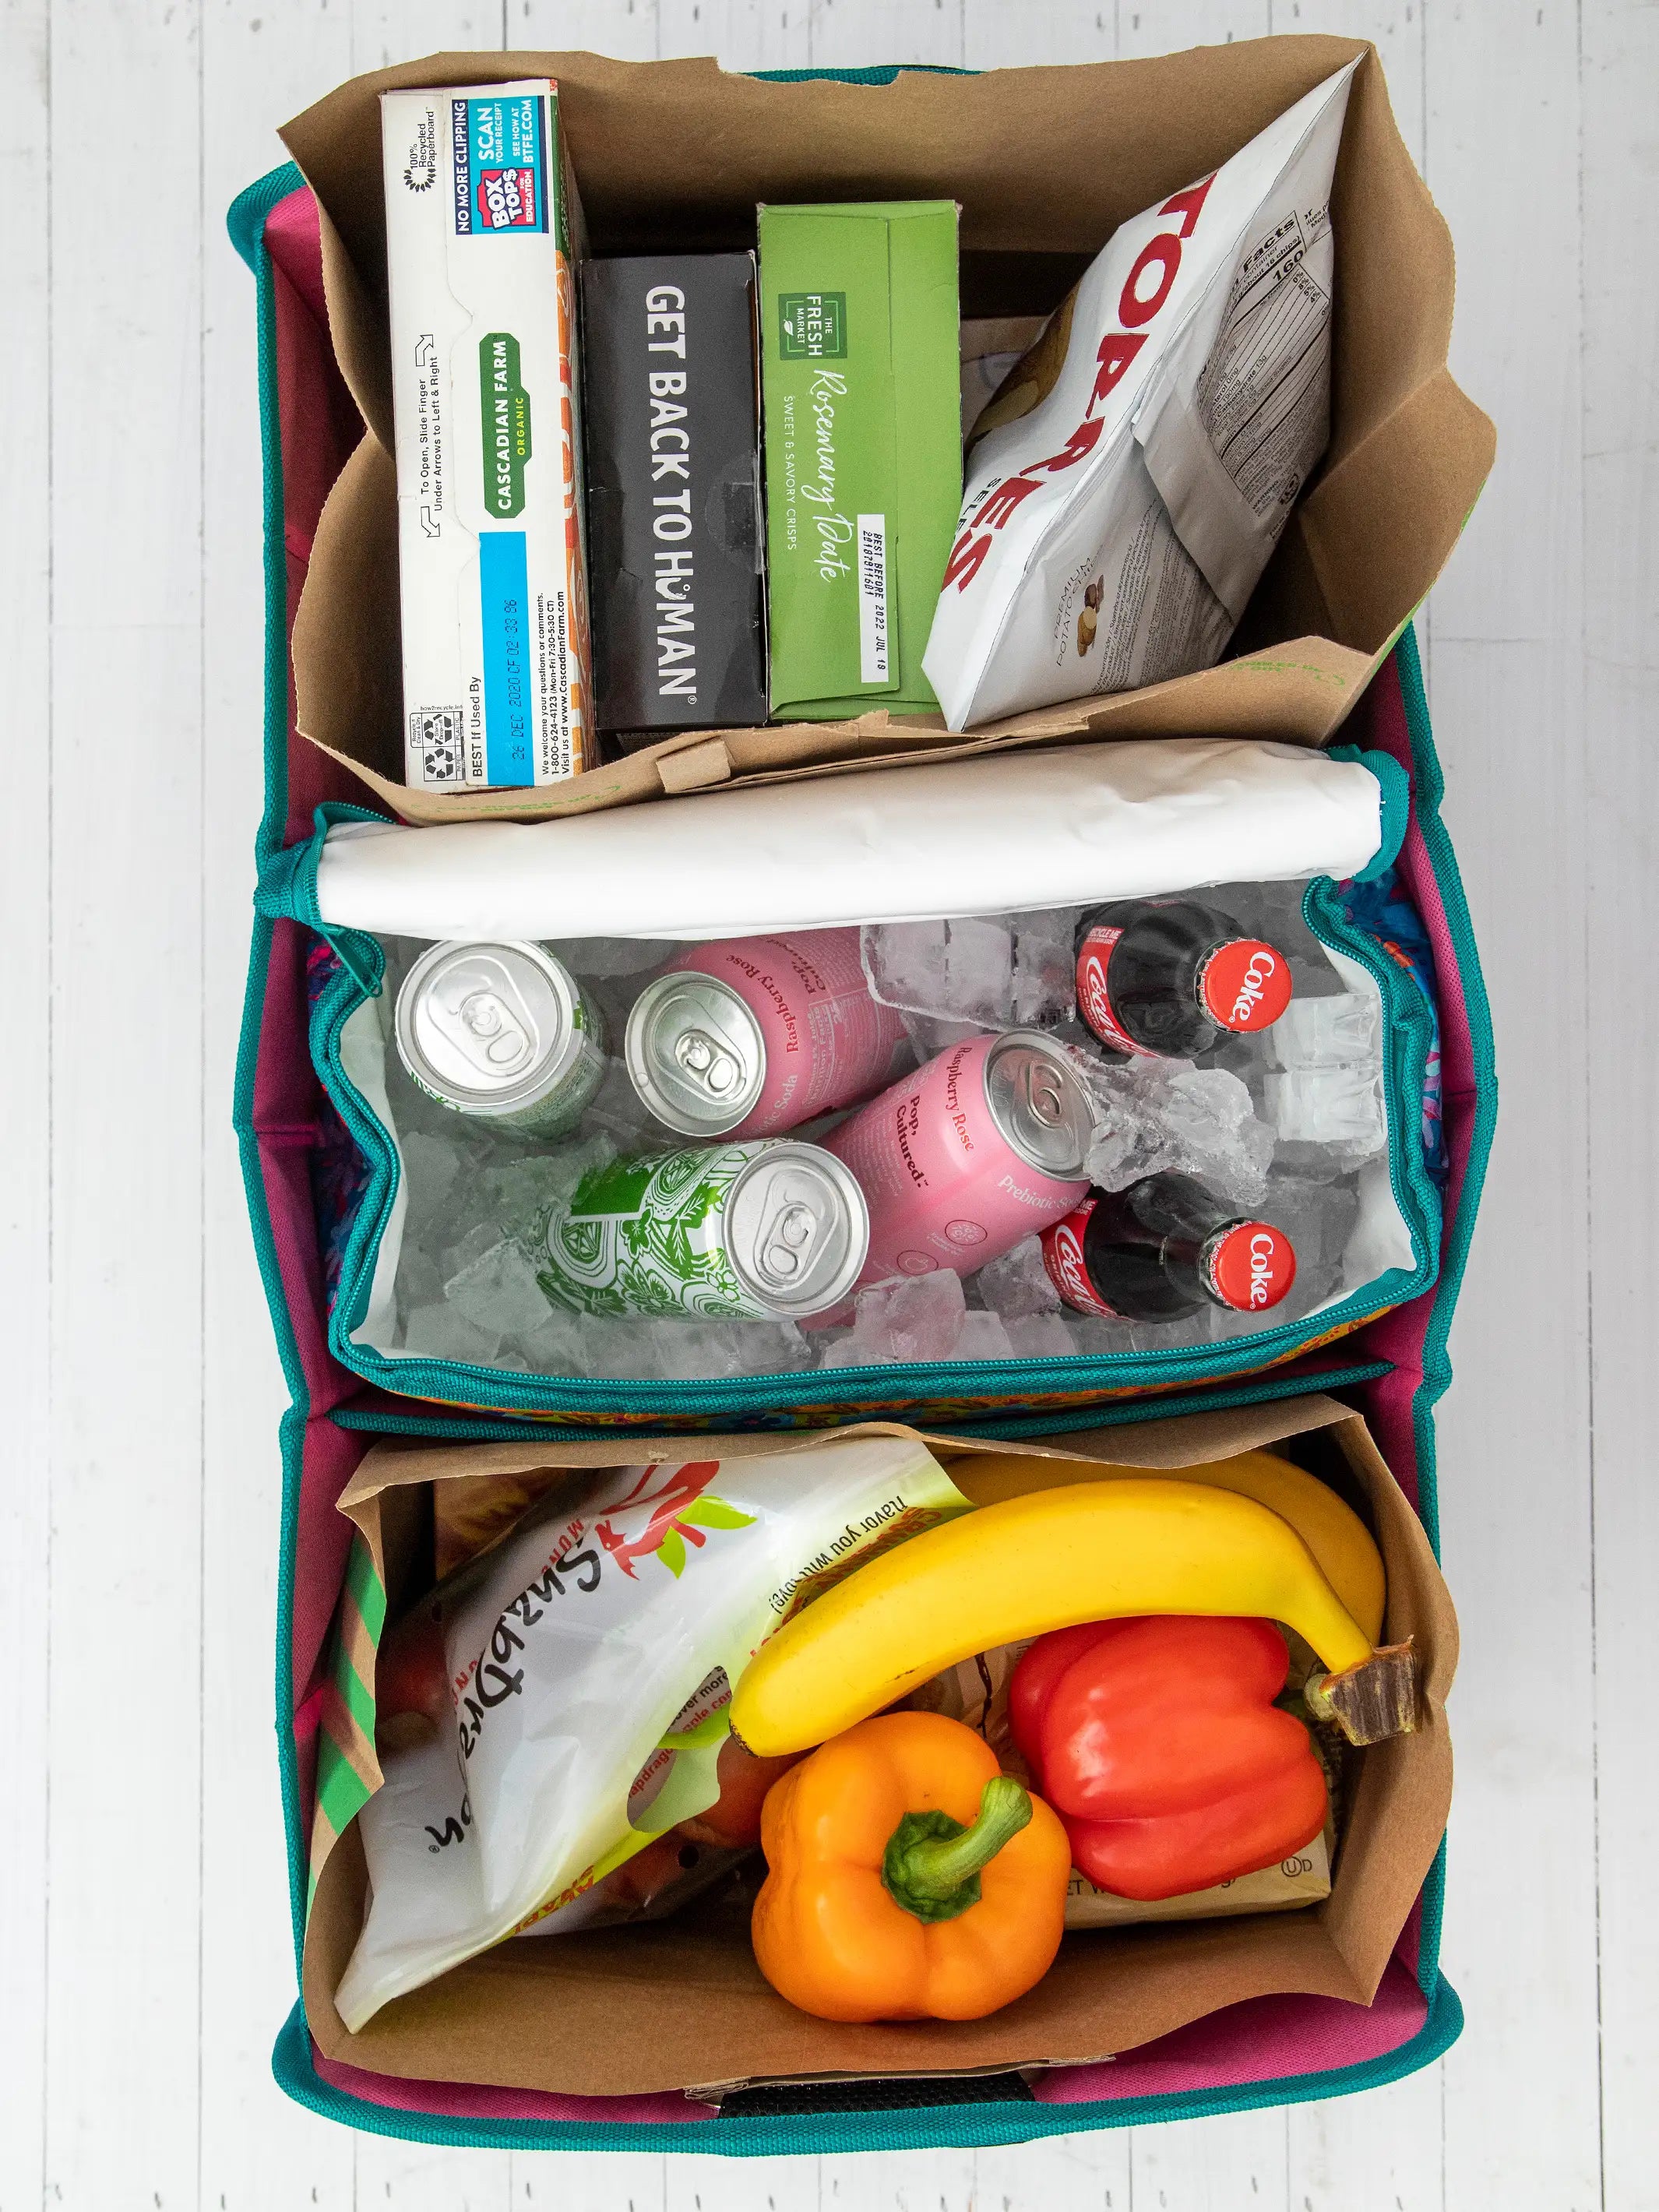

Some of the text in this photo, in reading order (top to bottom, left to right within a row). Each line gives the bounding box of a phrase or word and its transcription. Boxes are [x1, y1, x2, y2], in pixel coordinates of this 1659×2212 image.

[495, 103, 503, 143] RECEIPT
[512, 107, 519, 117] AT
[417, 123, 426, 167] Recycled
[477, 107, 494, 160] SCAN
[512, 118, 520, 143] HOW
[521, 100, 534, 163] BTFE.COM
[455, 102, 469, 231] NO MORE CLIPPING
[486, 177, 510, 228] BOX
[1243, 220, 1294, 273] Facts
[1243, 245, 1278, 283] container
[1266, 235, 1300, 268] 16 chips)
[1273, 250, 1304, 282] 160
[1293, 272, 1304, 284] 0%
[1298, 278, 1309, 290] 8%
[1304, 285, 1315, 296] 5%
[1310, 291, 1320, 303] 4%
[646, 285, 685, 359] GET
[796, 308, 805, 343] MARKET
[806, 295, 822, 355] FRESH
[431, 357, 440, 386] Right
[940, 173, 1218, 594] TORRES
[1217, 369, 1256, 417] Carbohydrate
[1256, 355, 1267, 368] 13g
[419, 379, 430, 413] Finger
[1223, 379, 1241, 403] 190mg
[433, 425, 440, 435] to
[494, 341, 511, 509] CASCADIAN FARM
[516, 398, 525, 455] ORGANIC
[650, 372, 690, 481] BACK
[784, 396, 794, 436] SWEET
[421, 447, 429, 477] Open,
[785, 453, 796, 504] SAVORY
[801, 369, 854, 583] Rosemary Date
[421, 483, 428, 494] To
[653, 489, 692, 541] TO
[787, 509, 796, 550] CRISPS
[873, 534, 882, 557] BEST
[874, 563, 884, 599] BEFORE
[1054, 558, 1091, 639] PREMIUM
[875, 605, 885, 630] 2022
[1056, 597, 1073, 666] POTATO
[538, 641, 544, 650] or
[876, 636, 886, 652] JUL
[470, 677, 481, 692] By
[537, 653, 546, 693] questions
[548, 658, 557, 693] (Mon-Fri
[556, 591, 569, 773] Visit us at www.CascadianFarm.com
[509, 678, 521, 707] 2020
[540, 696, 548, 715] your
[470, 699, 480, 729] Used
[512, 714, 523, 738] DEC
[512, 745, 525, 760] 26
[548, 696, 558, 774] 1-800-624-4123
[472, 743, 482, 777] BEST
[541, 760, 548, 774] We
[726, 954, 799, 1054] Raspberry Rose
[775, 1074, 798, 1109] Soda
[946, 1047, 974, 1152] Raspberry Rose
[911, 1094, 920, 1136] Pop,
[998, 1175, 1056, 1209] Prebiotic
[825, 1522, 862, 1557] you
